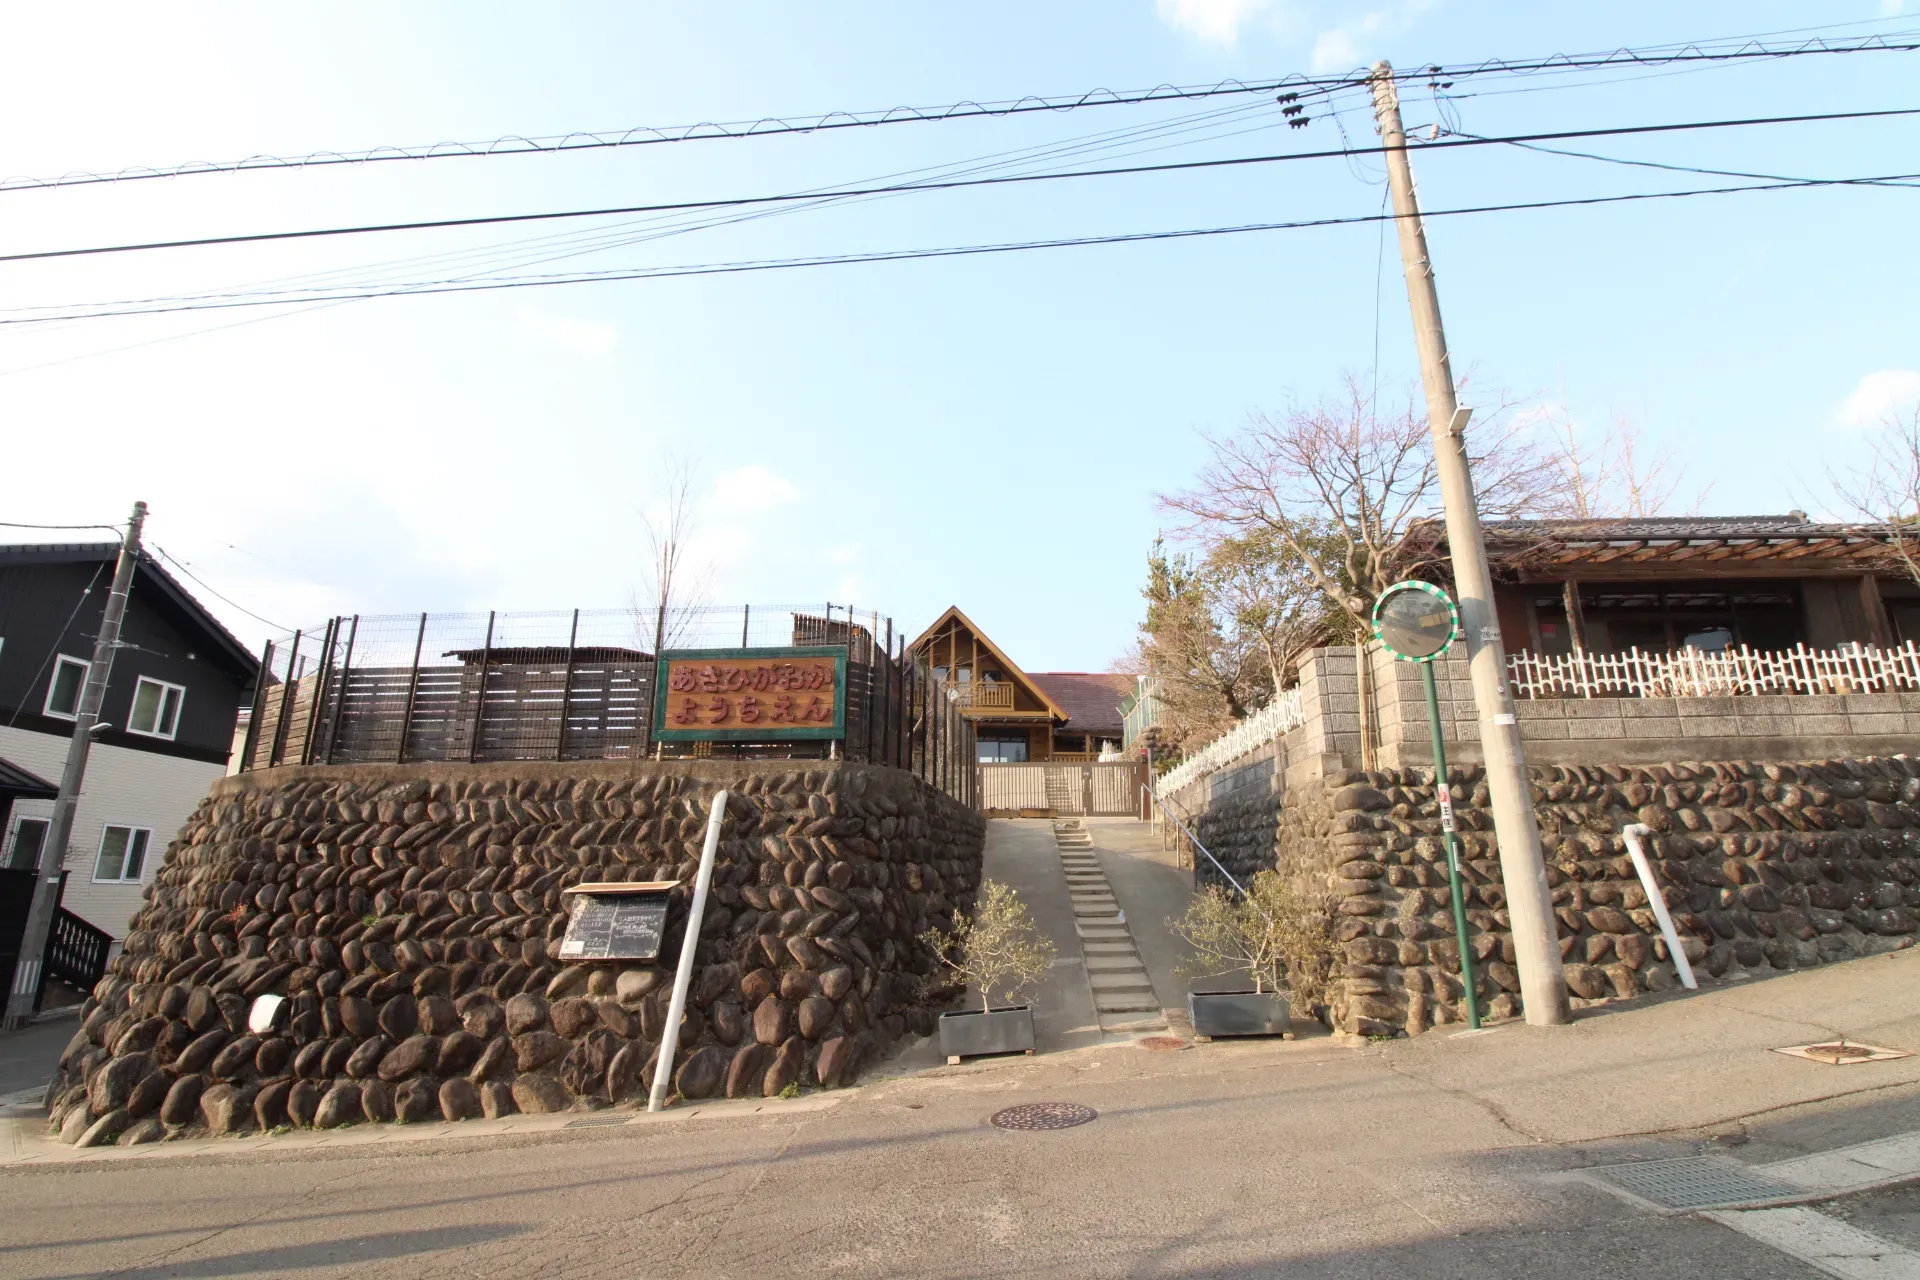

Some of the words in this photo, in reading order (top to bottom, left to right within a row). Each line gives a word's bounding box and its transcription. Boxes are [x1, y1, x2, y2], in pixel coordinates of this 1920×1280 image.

[671, 664, 832, 692] あさひがおか
[673, 695, 831, 724] ようちえん
